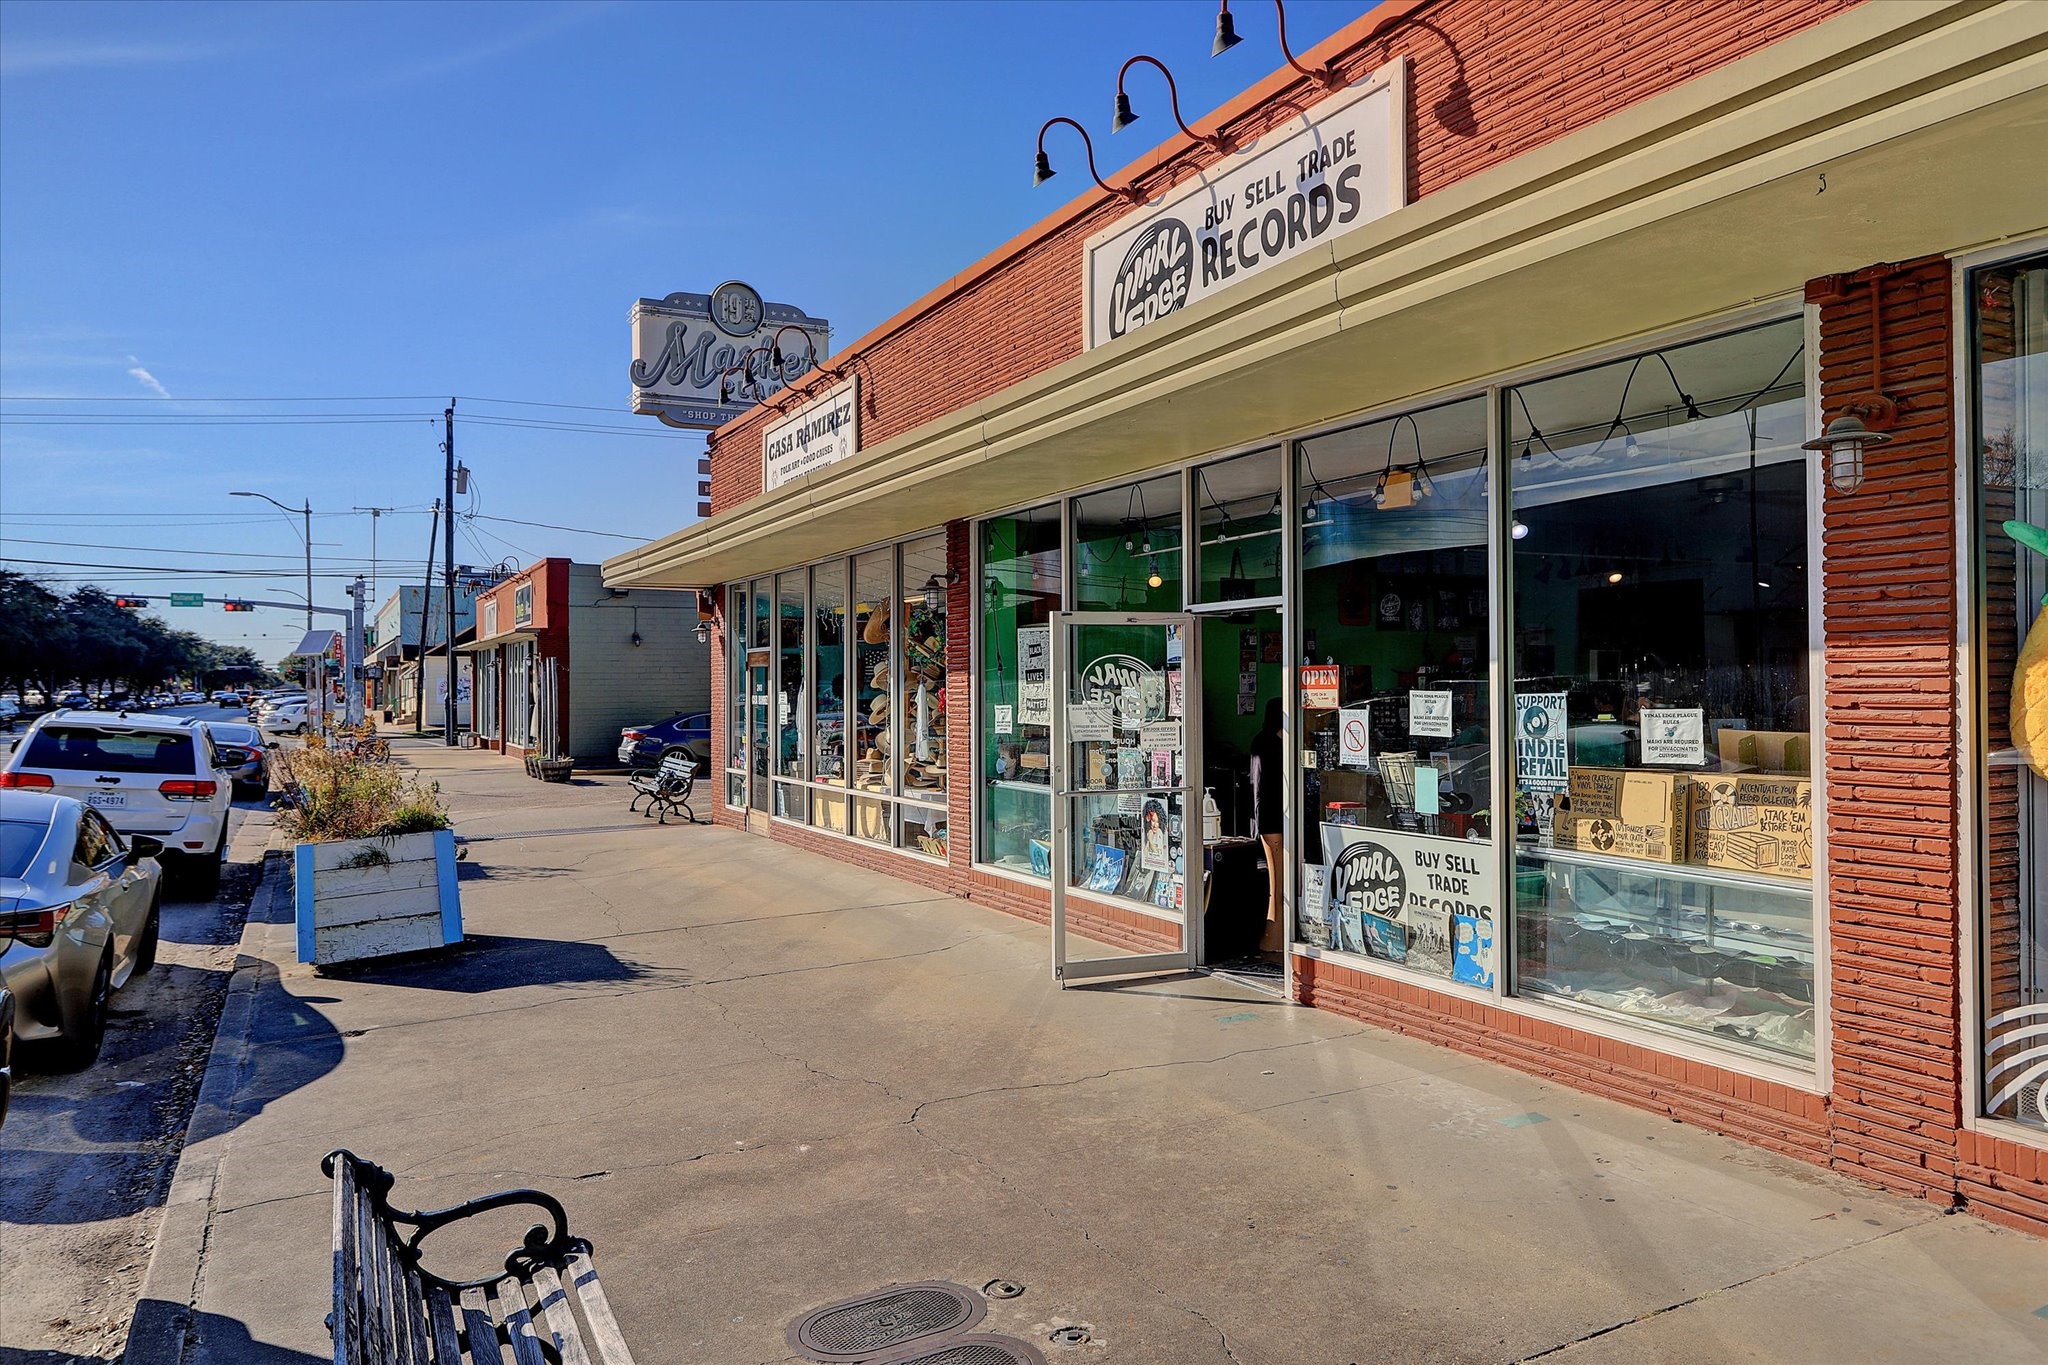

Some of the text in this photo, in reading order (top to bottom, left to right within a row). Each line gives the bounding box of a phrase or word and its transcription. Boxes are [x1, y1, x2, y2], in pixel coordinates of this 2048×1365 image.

[1205, 130, 1356, 230] BUY SELL TRADE
[1202, 164, 1361, 288] RECORDS
[769, 402, 851, 461] CASA RAMIREZ
[816, 444, 833, 459] CAUSES
[1029, 645, 1042, 656] BLACK
[1027, 672, 1044, 681] LIVES
[1301, 670, 1337, 686] OPEN
[1027, 699, 1047, 709] MATTER
[1517, 695, 1564, 710] SUPPORT
[1518, 739, 1565, 757] INDIE
[1519, 758, 1567, 777] RETAIL
[95, 775, 121, 785] Jeep
[1696, 782, 1709, 791] 100
[1740, 784, 1797, 794] ACCENTUATE YOUR
[1740, 794, 1797, 805] RECORD COLLECTION
[1675, 801, 1683, 824] CLASSIC
[1715, 805, 1754, 830] CRATE
[1763, 809, 1806, 823] STACK 'EM
[1616, 823, 1643, 834] CUSTOMIZE
[1789, 821, 1803, 833] 'EM
[1616, 833, 1644, 842] YOUR CRATE
[1709, 842, 1725, 852] EASY
[1415, 850, 1480, 875] BUY SELL
[1694, 849, 1724, 862] ASSEMBLY
[1427, 874, 1469, 895] TRADE
[1346, 886, 1400, 911] EDGE
